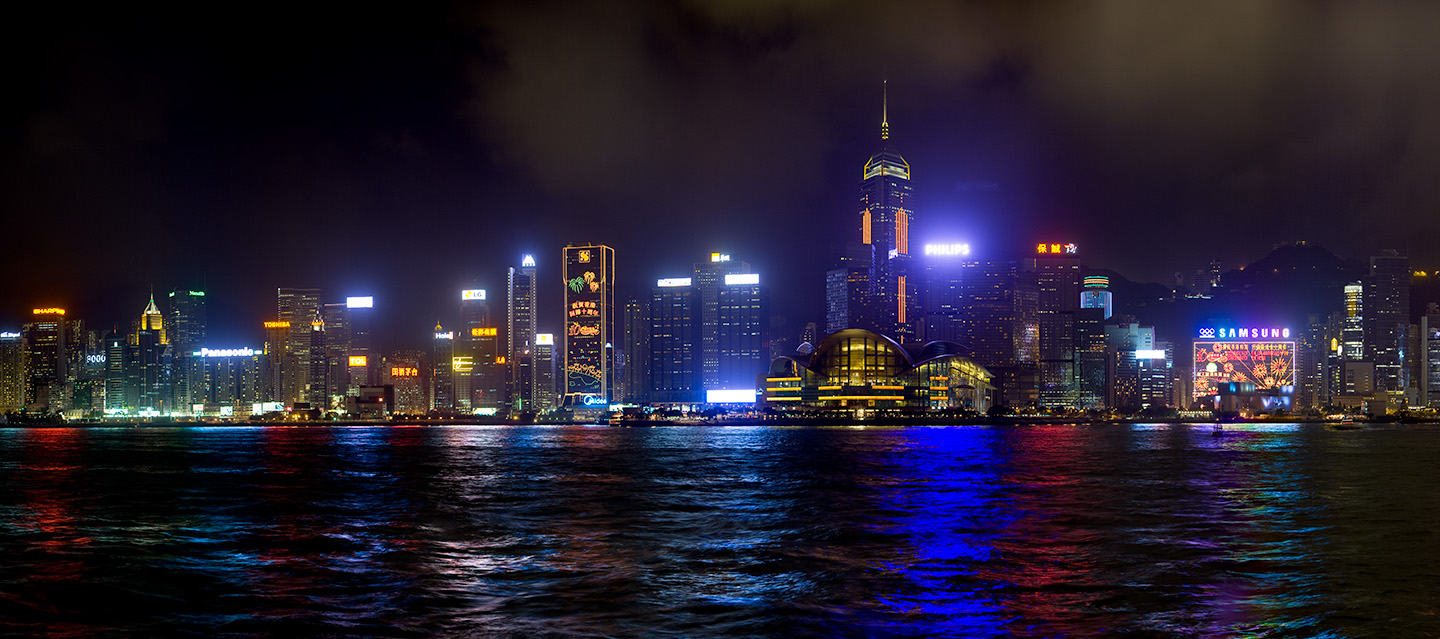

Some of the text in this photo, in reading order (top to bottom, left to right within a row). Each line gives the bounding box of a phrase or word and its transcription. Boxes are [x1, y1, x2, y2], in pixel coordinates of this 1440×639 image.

[925, 244, 970, 255] PHILIPS
[1219, 328, 1290, 338] SAMSUNG
[201, 346, 254, 357] Panasonic
